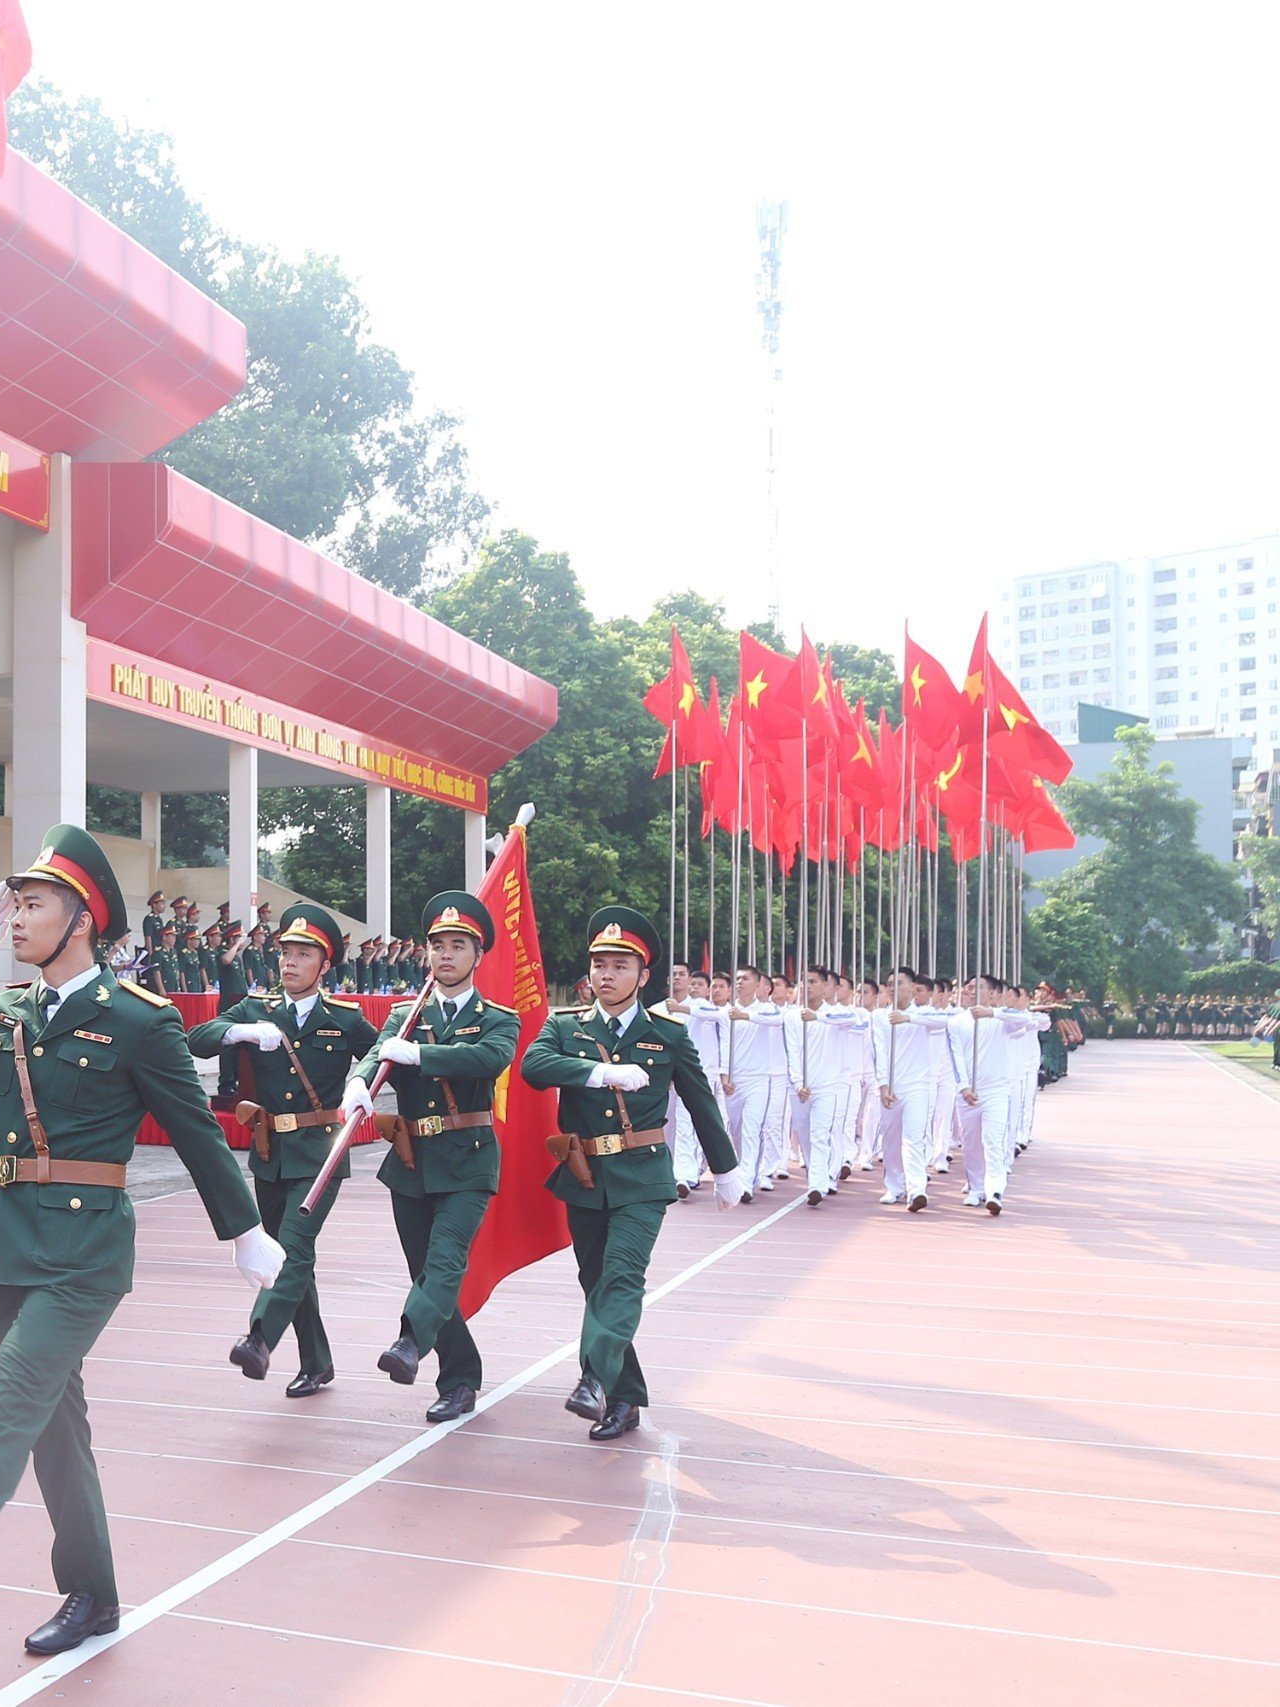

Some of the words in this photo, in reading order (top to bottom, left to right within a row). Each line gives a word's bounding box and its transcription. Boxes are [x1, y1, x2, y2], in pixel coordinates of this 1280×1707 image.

[111, 663, 147, 700] PHÁT
[148, 675, 175, 710] HUY
[222, 696, 258, 736] THỐNG
[294, 725, 315, 755] ANH
